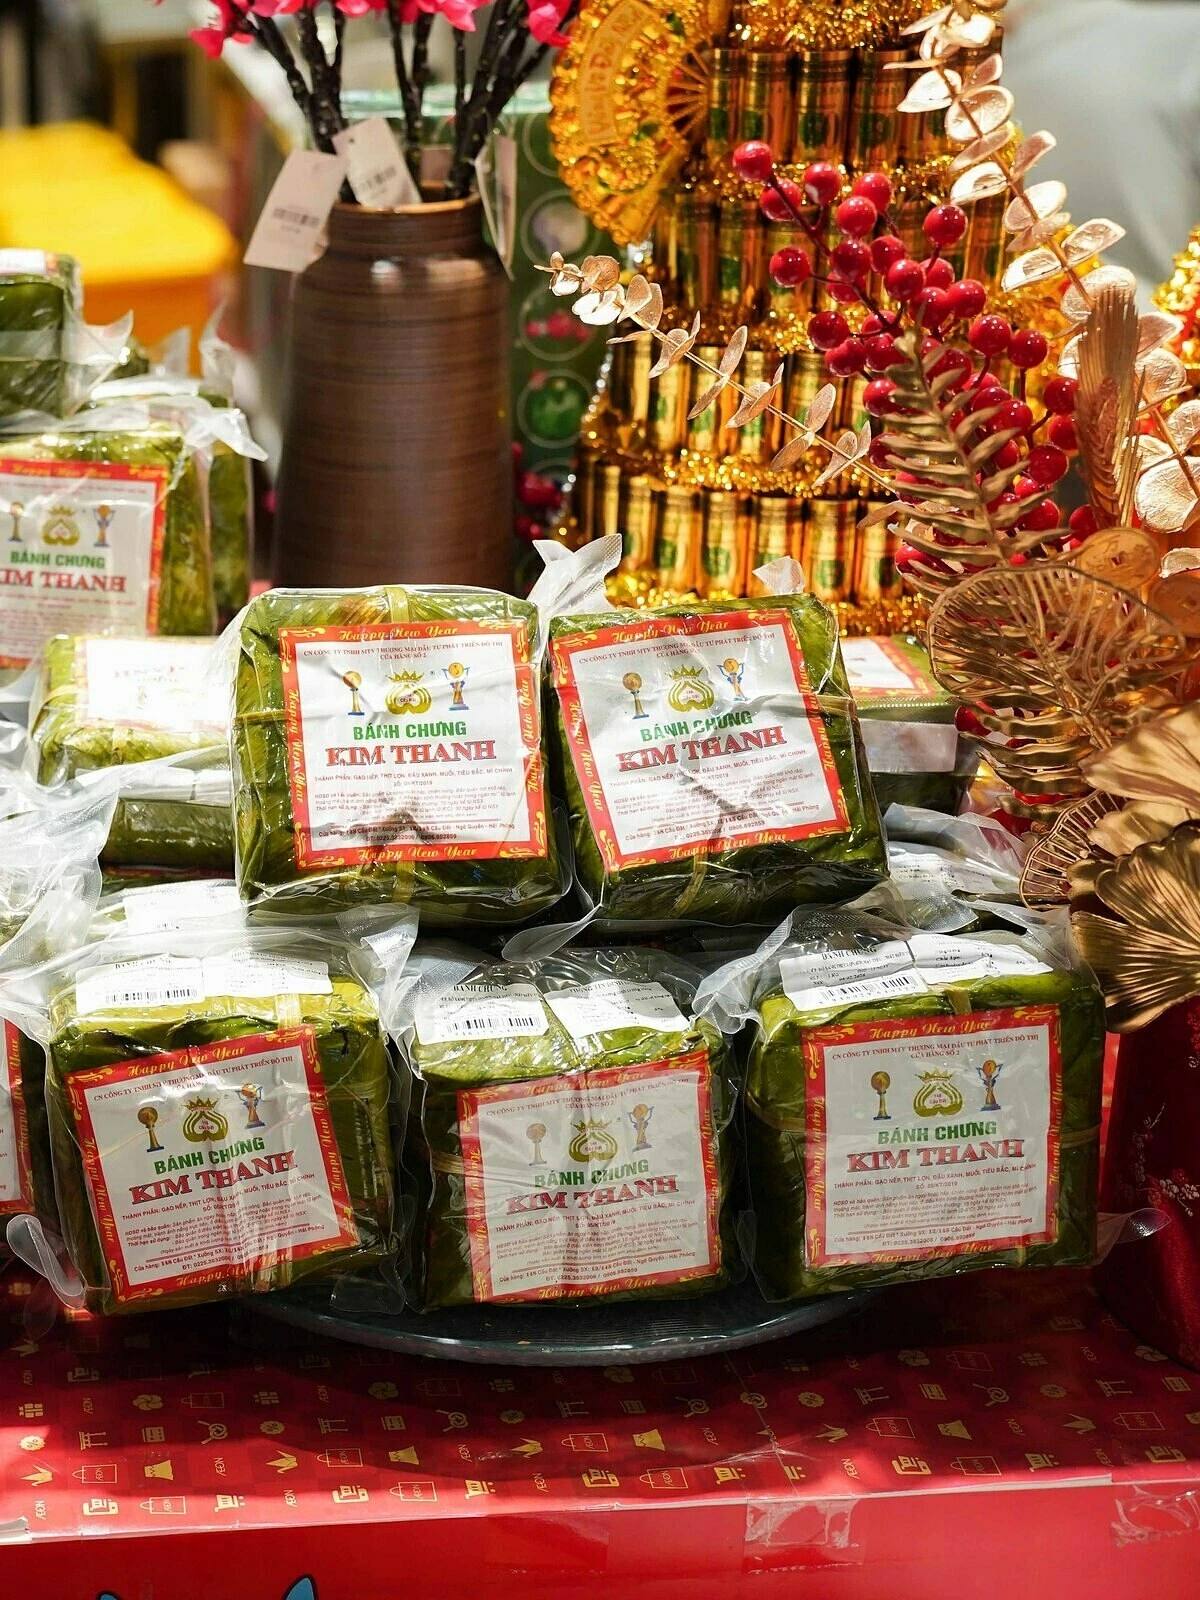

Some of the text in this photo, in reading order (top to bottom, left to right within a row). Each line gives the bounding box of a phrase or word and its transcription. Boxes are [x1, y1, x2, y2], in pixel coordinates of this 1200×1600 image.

[9, 549, 52, 568] BÁNH
[39, 570, 127, 593] THANH
[339, 628, 388, 641] Happy
[426, 625, 460, 637] Year
[612, 628, 659, 642] Happy
[698, 620, 730, 632] Year
[353, 723, 400, 741] BÁNH
[640, 719, 690, 742] BÁNH
[325, 740, 497, 767] KIM THANH
[616, 726, 788, 771] KIM THANH
[358, 846, 477, 861] Happy New Year
[668, 832, 788, 859] Happy New Year
[869, 1019, 994, 1039] Happy New Year
[127, 1060, 175, 1075] Happy
[212, 1046, 245, 1059] Year
[877, 1126, 929, 1145] BÁNH
[154, 1153, 204, 1175] BÁNH
[847, 1139, 1024, 1172] KIM THANH
[130, 1150, 298, 1205] KIM THANH
[534, 1170, 585, 1188] BÁNH
[506, 1174, 679, 1215] KIM THANH
[538, 1287, 585, 1300] Happy
[624, 1278, 658, 1290] Year
